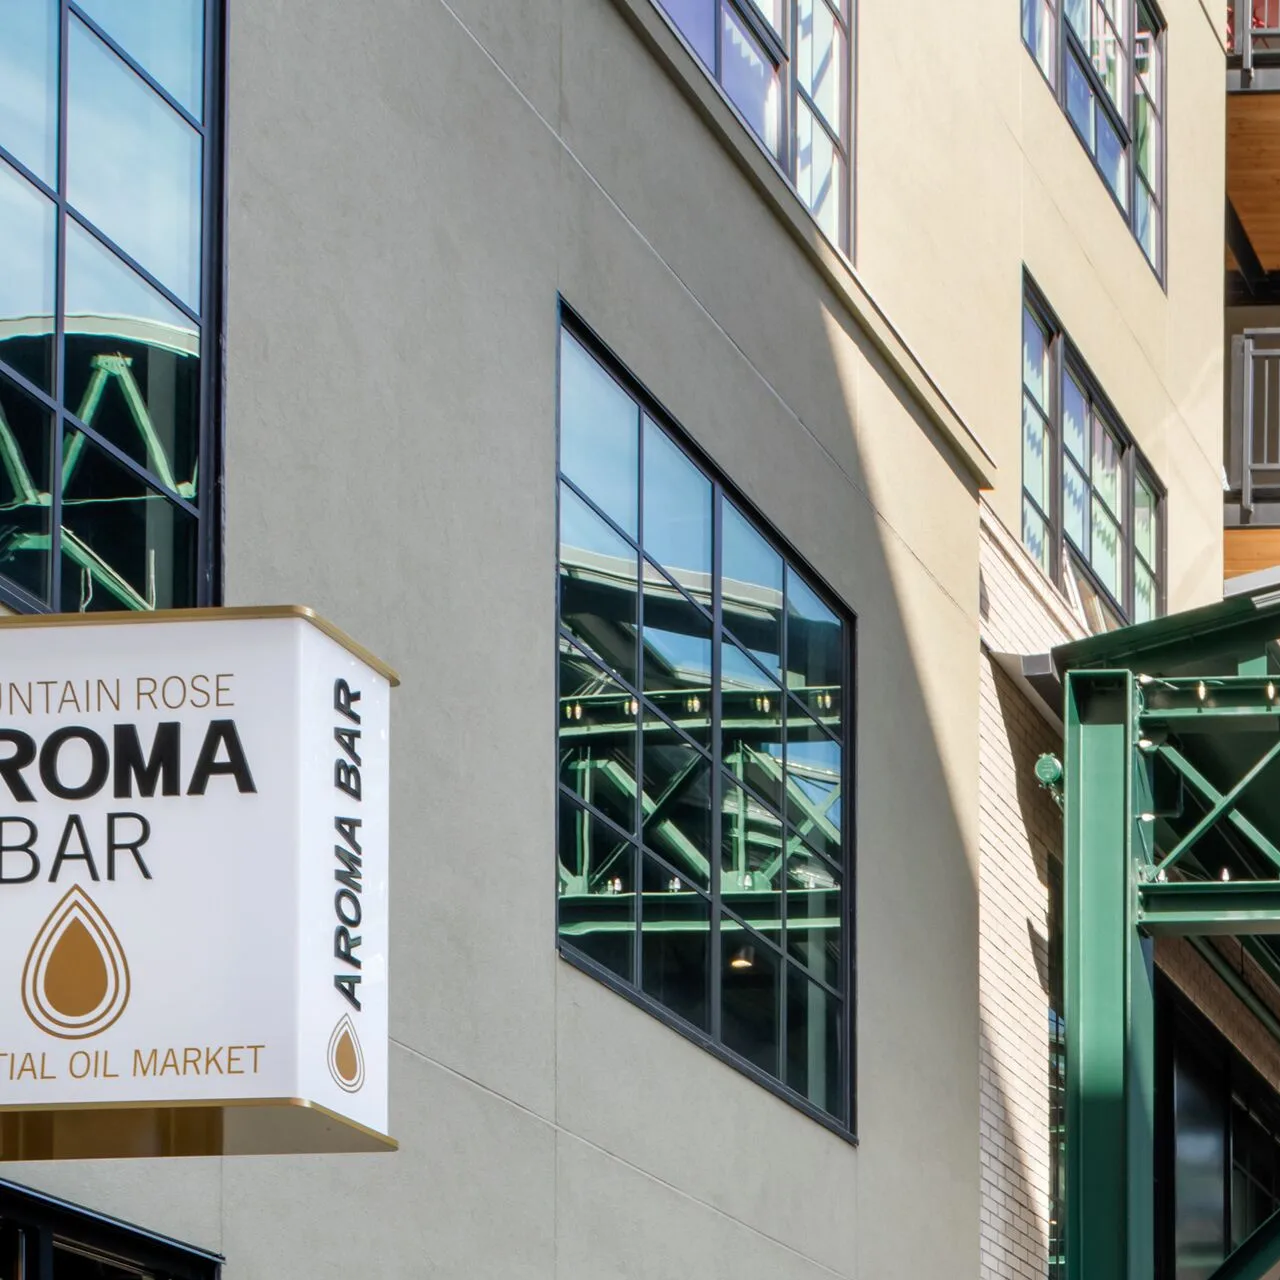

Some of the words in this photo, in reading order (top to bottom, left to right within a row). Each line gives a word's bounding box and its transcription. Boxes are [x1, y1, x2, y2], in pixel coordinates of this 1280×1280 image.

[0, 678, 120, 715] NTAIN
[136, 673, 235, 711] ROSE
[333, 677, 363, 802] BAR
[0, 811, 153, 885] BAR
[333, 816, 363, 1013] AROMA
[69, 1050, 119, 1079] OIL
[133, 1045, 265, 1076] MARKET
